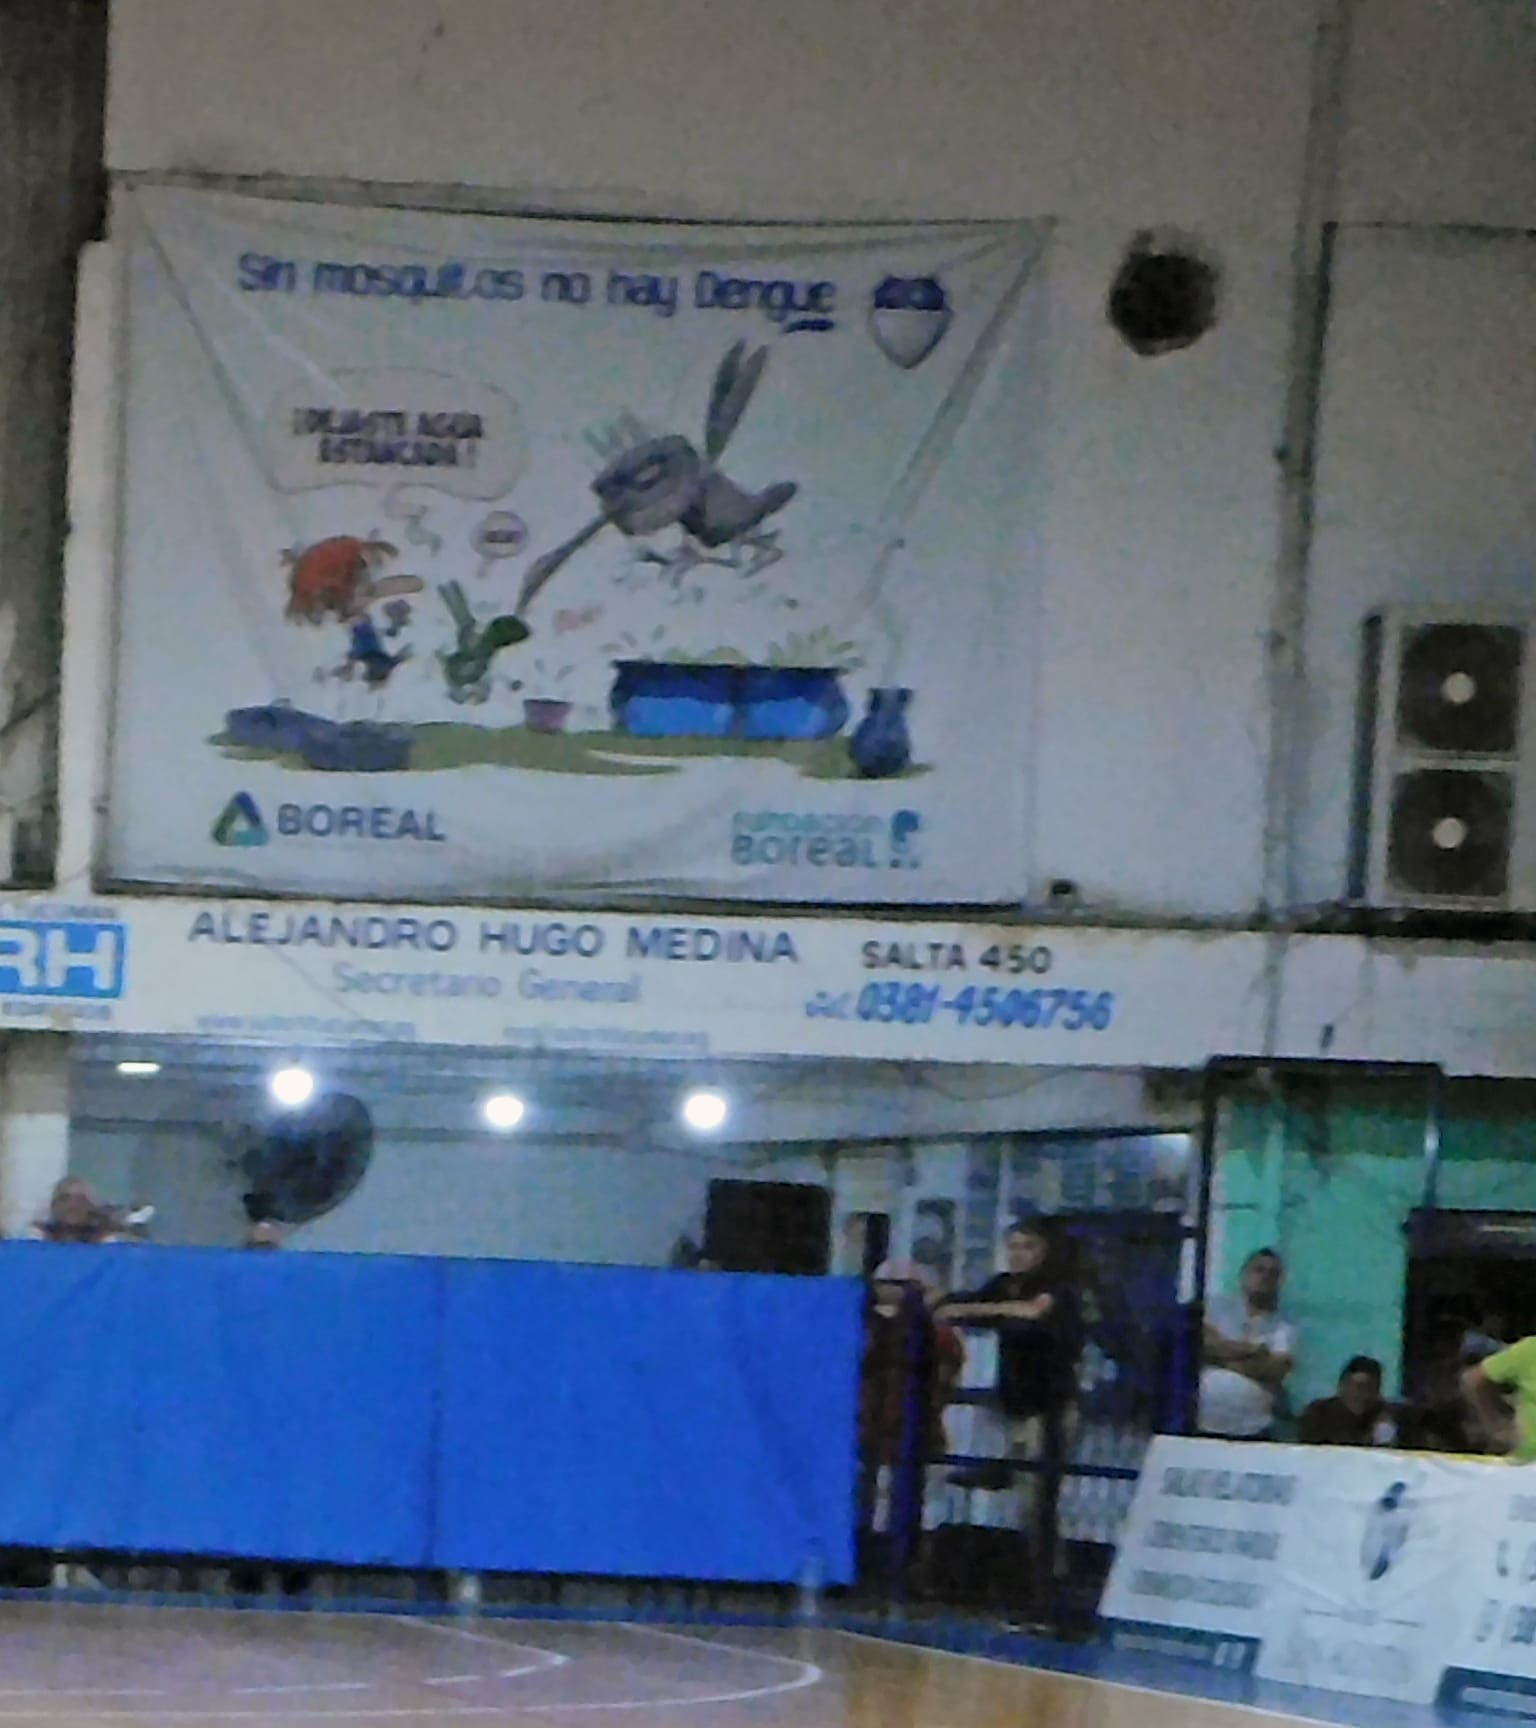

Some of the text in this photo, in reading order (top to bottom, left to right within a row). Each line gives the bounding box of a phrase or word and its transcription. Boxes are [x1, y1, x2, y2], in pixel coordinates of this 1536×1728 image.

[238, 252, 296, 292] Sin
[541, 271, 591, 303] no
[607, 268, 679, 318] hay
[694, 270, 835, 322] Dengue
[276, 803, 446, 841] BOREAL
[188, 911, 799, 964] ALEJANDRO HUGO MEDINA
[860, 940, 1053, 975] SALTA 450
[333, 960, 643, 1004] Secretario General
